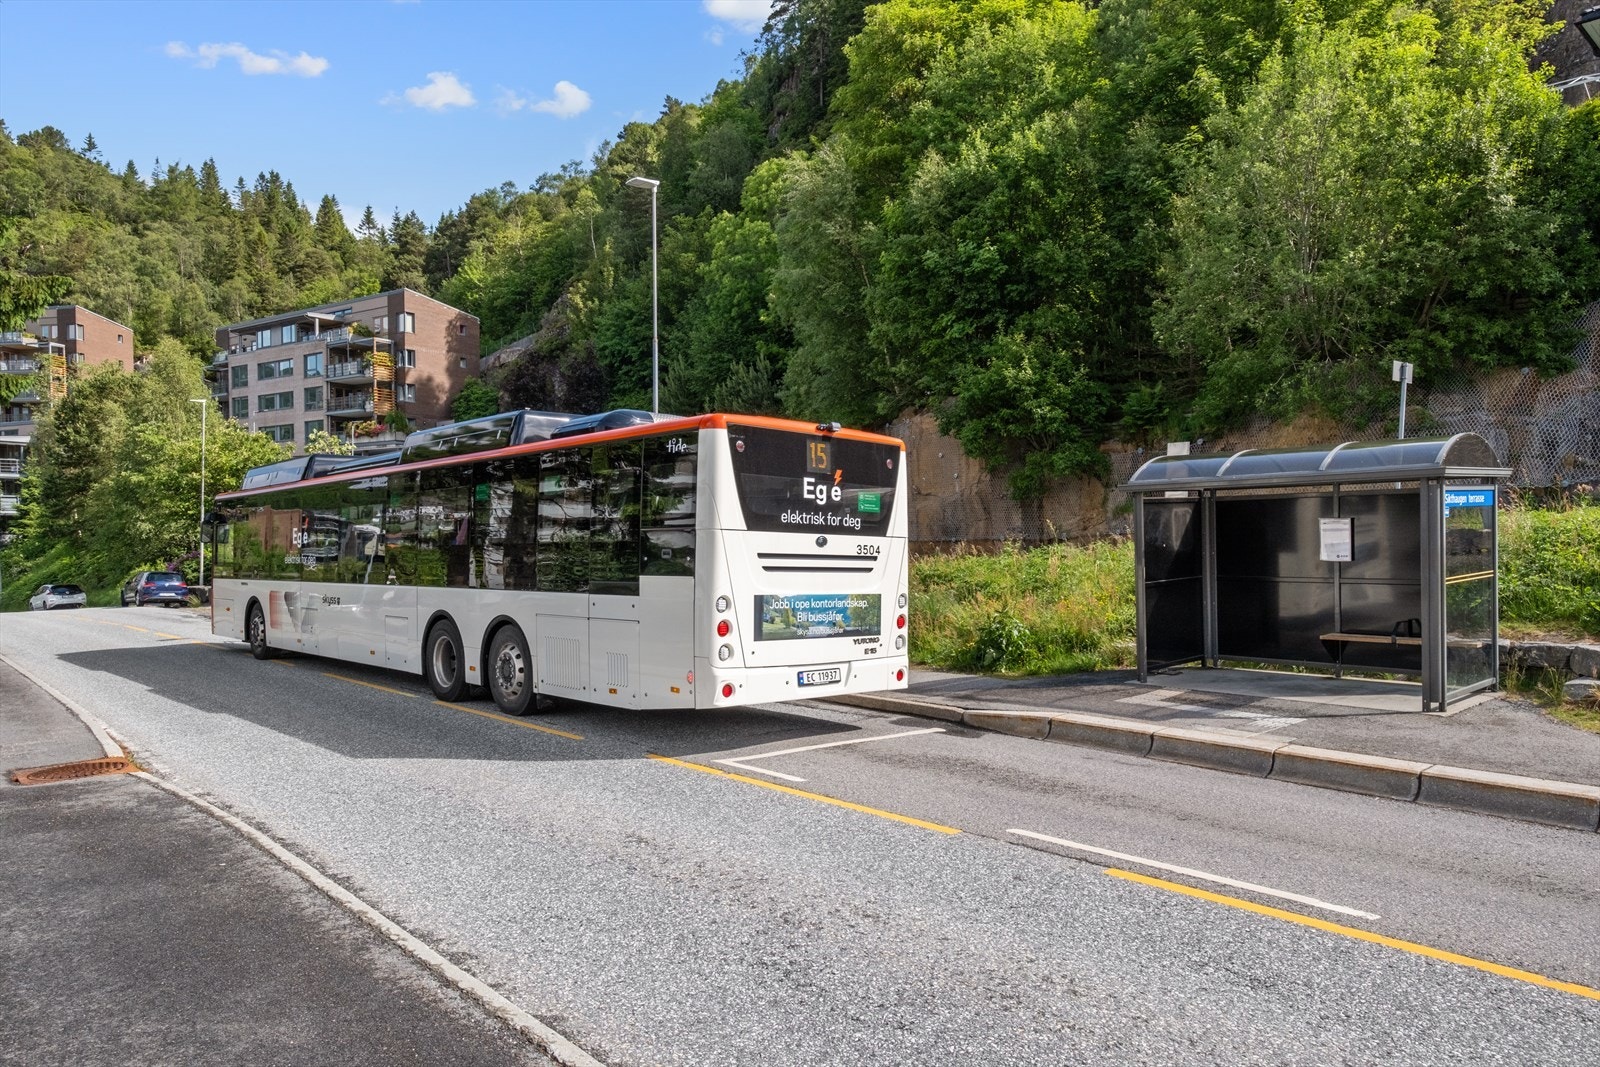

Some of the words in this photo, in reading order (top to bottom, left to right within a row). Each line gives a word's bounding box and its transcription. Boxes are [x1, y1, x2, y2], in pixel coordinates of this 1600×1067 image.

[666, 438, 687, 454] tide
[809, 442, 827, 469] 15
[803, 477, 827, 505] Eg
[781, 509, 825, 525] elektrisk
[827, 511, 840, 526] for
[843, 513, 861, 530] deg
[856, 544, 881, 556] 3504
[769, 598, 790, 609] Jobb
[795, 600, 810, 610] ope
[811, 598, 869, 609] kontorlandskap.
[797, 611, 808, 622] Bli
[808, 612, 845, 623] bussjåfør.
[852, 637, 880, 645] YUTONG
[806, 672, 816, 682] EC
[818, 670, 837, 681] 11937
